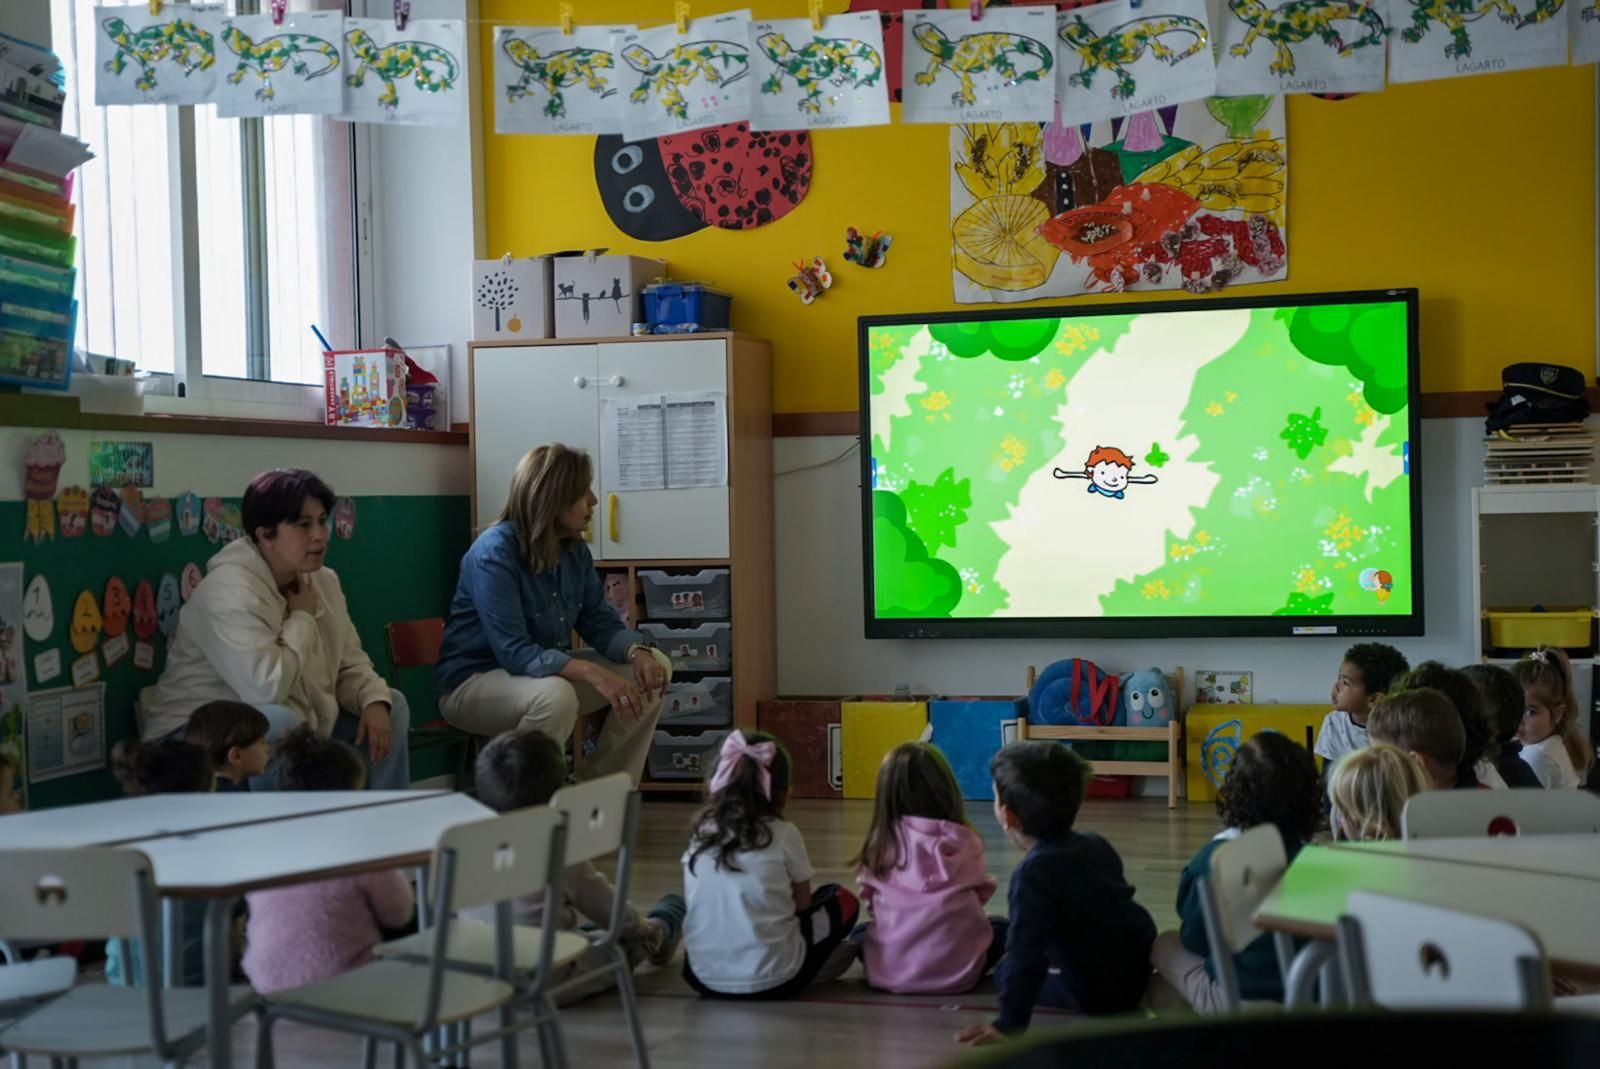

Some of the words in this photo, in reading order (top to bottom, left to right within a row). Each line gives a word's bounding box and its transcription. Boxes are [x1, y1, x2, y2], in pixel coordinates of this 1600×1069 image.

[1456, 59, 1506, 73] LAGARTO
[1280, 79, 1328, 91] LAGARTO
[1123, 94, 1167, 113] LAGARTO
[807, 115, 848, 126] LAGARTO
[960, 110, 1001, 121] LAGARTO
[552, 121, 593, 132] LAGARTO
[32, 586, 41, 605] 1
[111, 585, 122, 606] 3
[162, 582, 173, 601] 5
